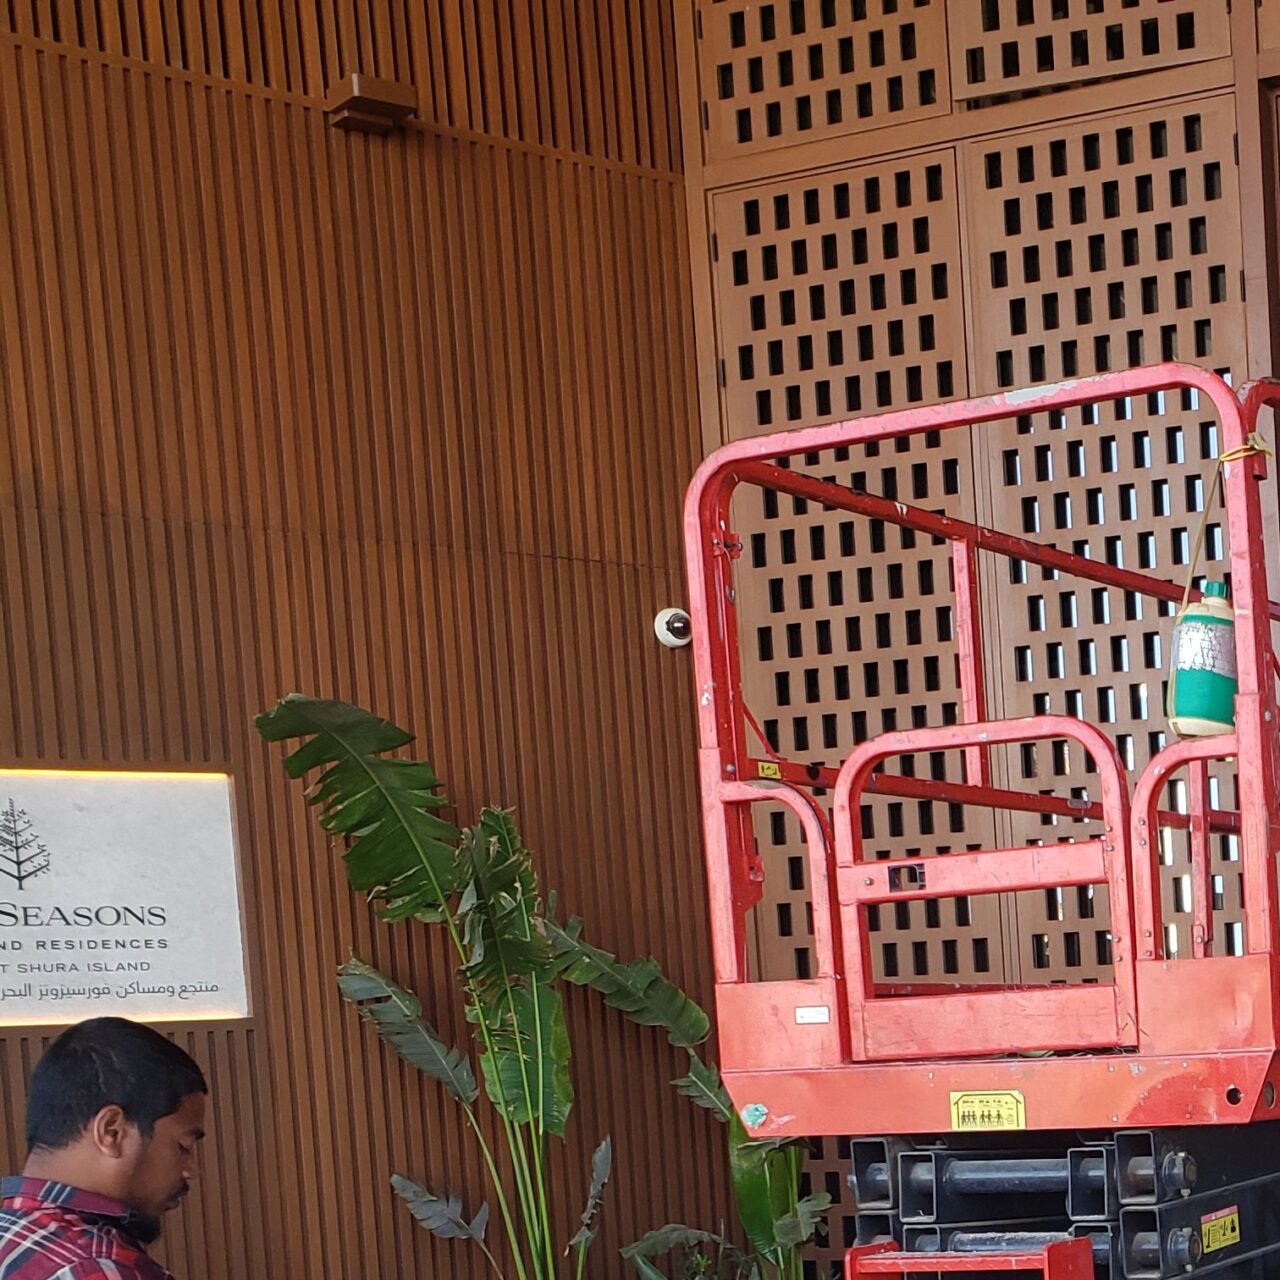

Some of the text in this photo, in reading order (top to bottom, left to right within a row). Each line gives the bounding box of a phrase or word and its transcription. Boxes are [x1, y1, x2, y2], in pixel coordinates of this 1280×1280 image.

[0, 901, 167, 927] SEASONS
[36, 938, 168, 950] RESIDENCES
[17, 962, 80, 974] SHURA
[87, 961, 151, 973] ISLAND
[115, 980, 175, 999] ومساكن
[178, 981, 219, 999] منتجع
